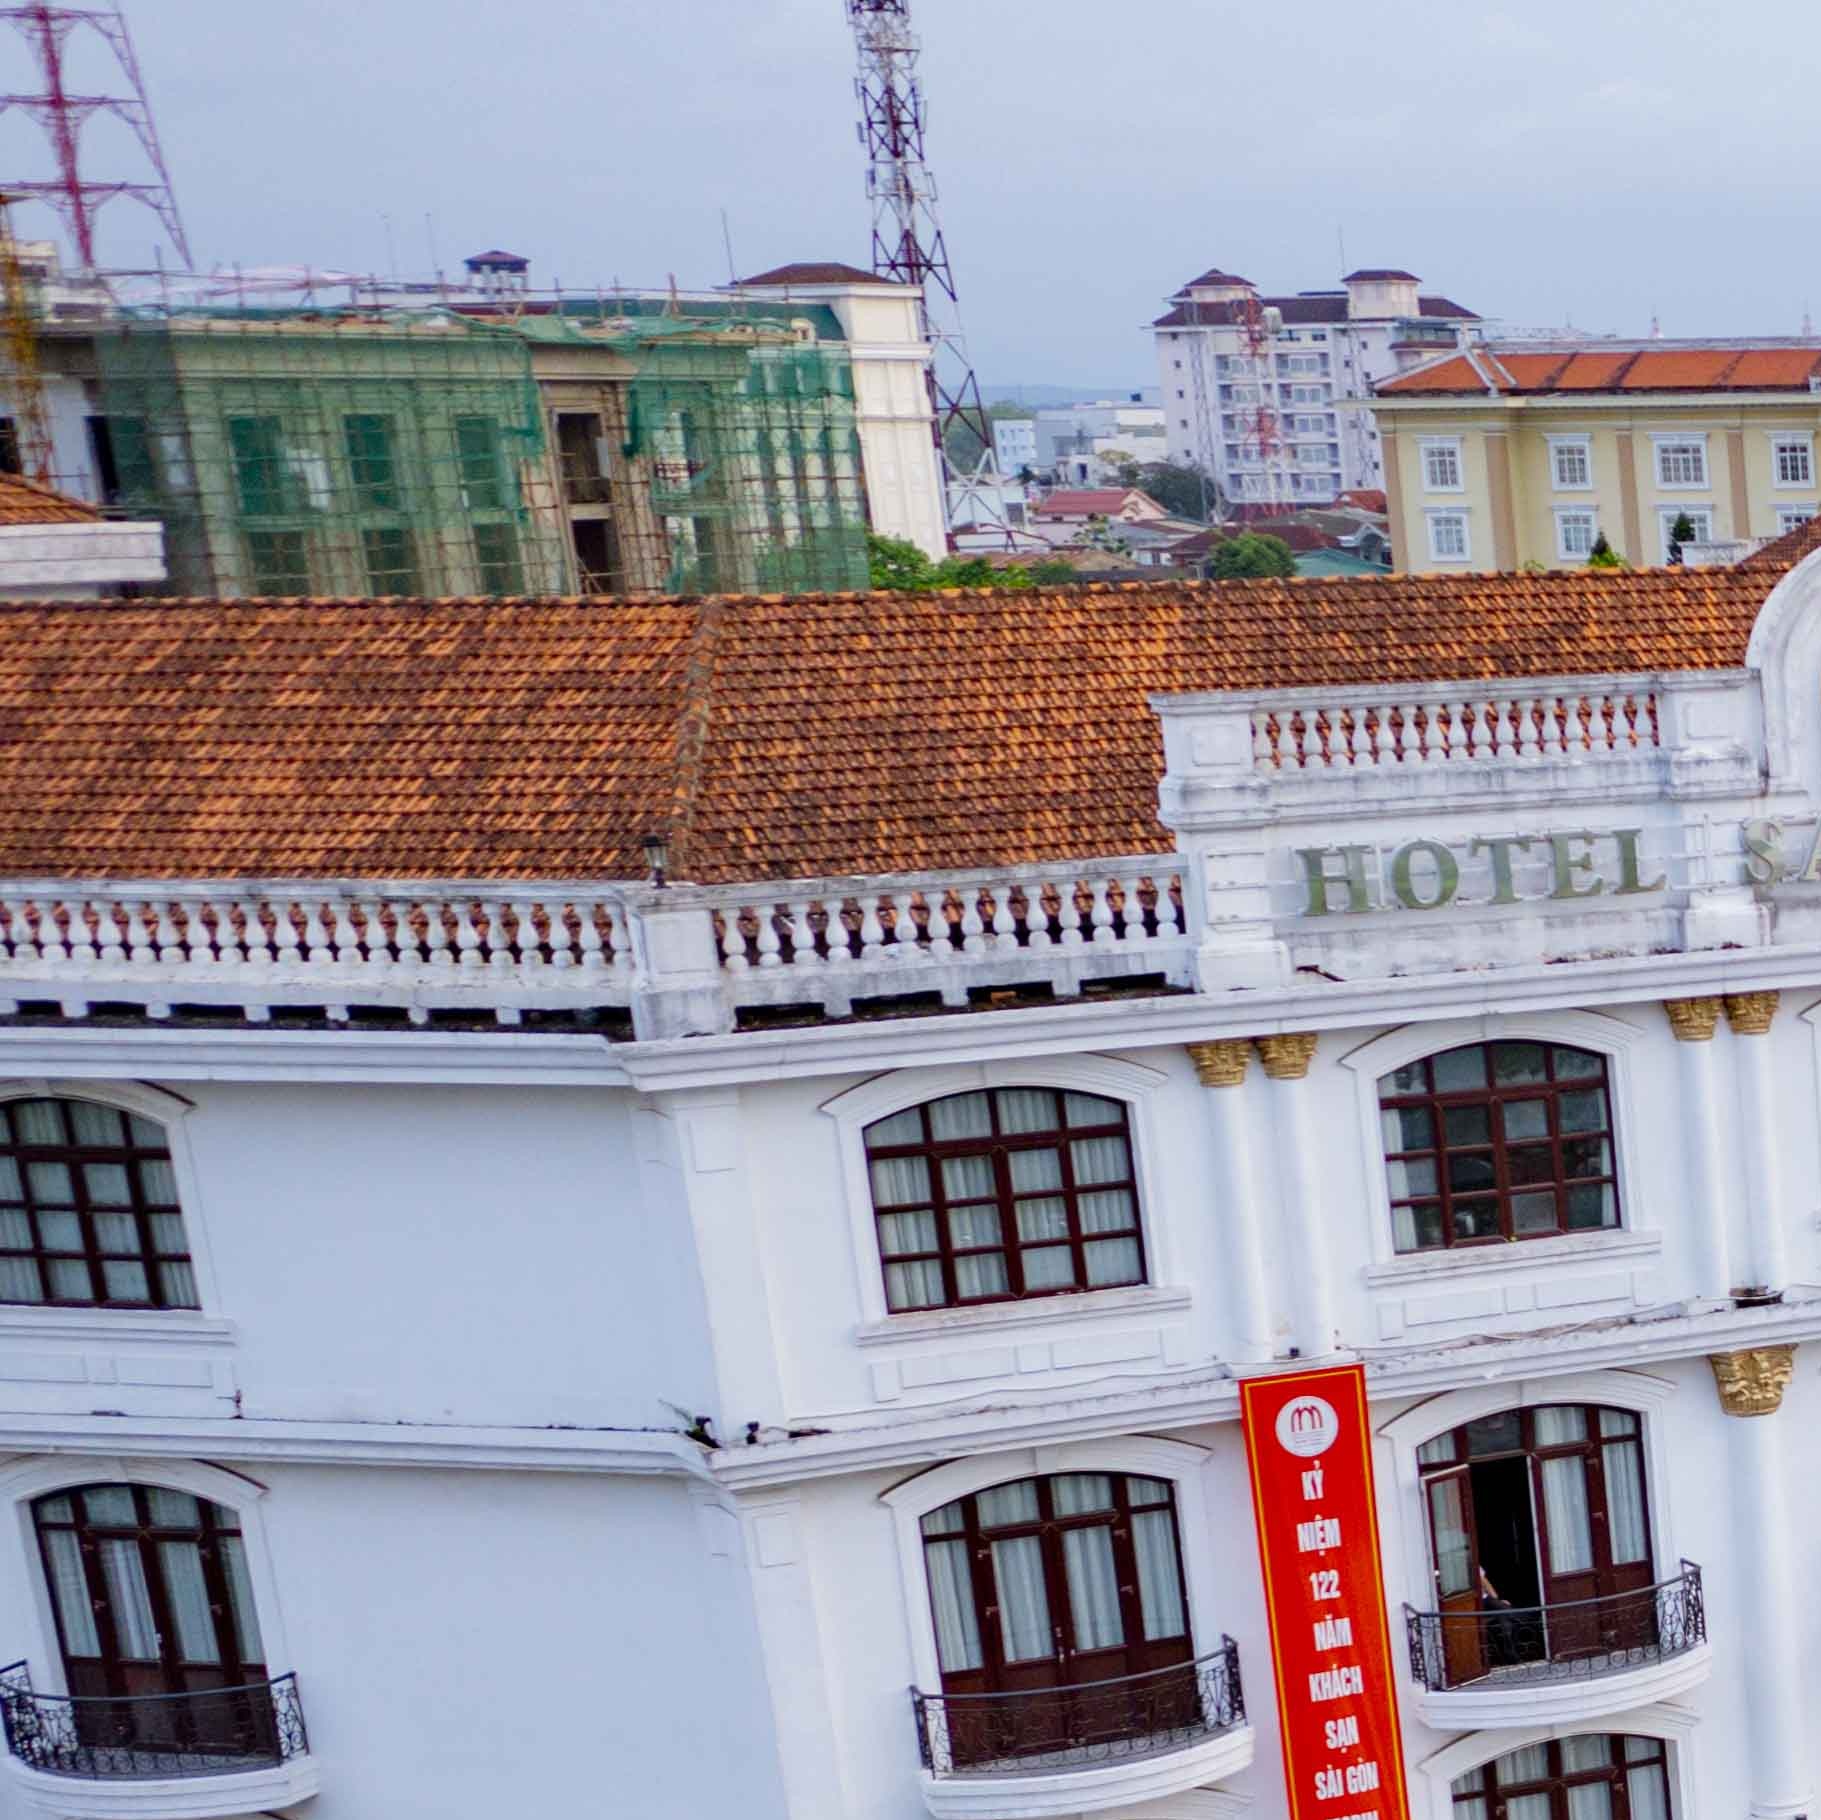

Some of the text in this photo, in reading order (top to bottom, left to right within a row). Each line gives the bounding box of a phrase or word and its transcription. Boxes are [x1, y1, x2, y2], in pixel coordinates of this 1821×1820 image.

[1297, 827, 1666, 919] HOTEL
[1297, 1515, 1341, 1556] NIỆM
[1310, 1571, 1340, 1600] 122
[1314, 1615, 1351, 1651] NĂM
[1309, 1662, 1364, 1702] KHÁCH
[1326, 1712, 1359, 1755] SẠN
[1315, 1764, 1343, 1801] SÀI
